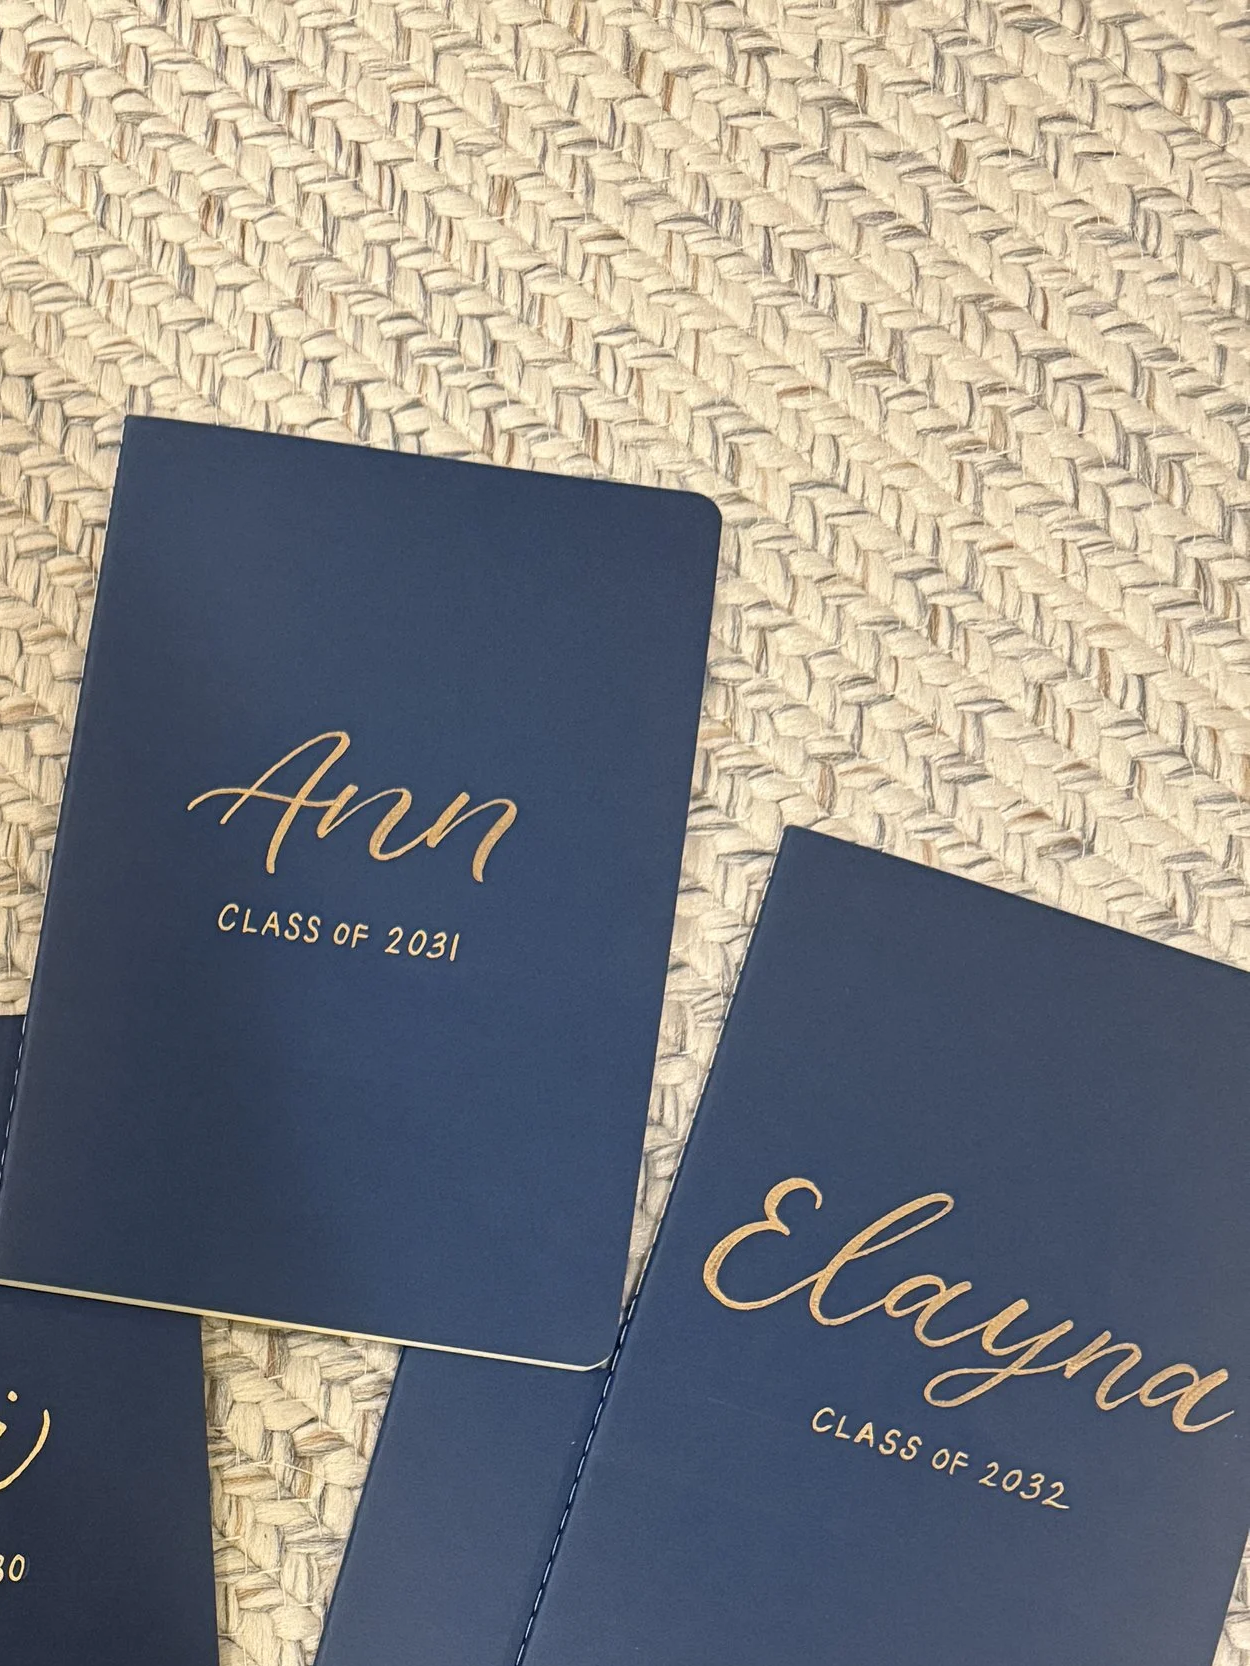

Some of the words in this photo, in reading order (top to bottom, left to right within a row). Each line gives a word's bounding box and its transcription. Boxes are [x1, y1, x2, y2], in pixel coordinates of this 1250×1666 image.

[186, 730, 519, 883] Ann
[216, 903, 321, 944] CLASS
[332, 922, 370, 947] OF
[384, 927, 460, 961] 2031
[702, 1177, 1235, 1434] Elayna
[810, 1407, 922, 1462] CLASS
[930, 1448, 970, 1474] OF
[978, 1462, 1071, 1510] 2032
